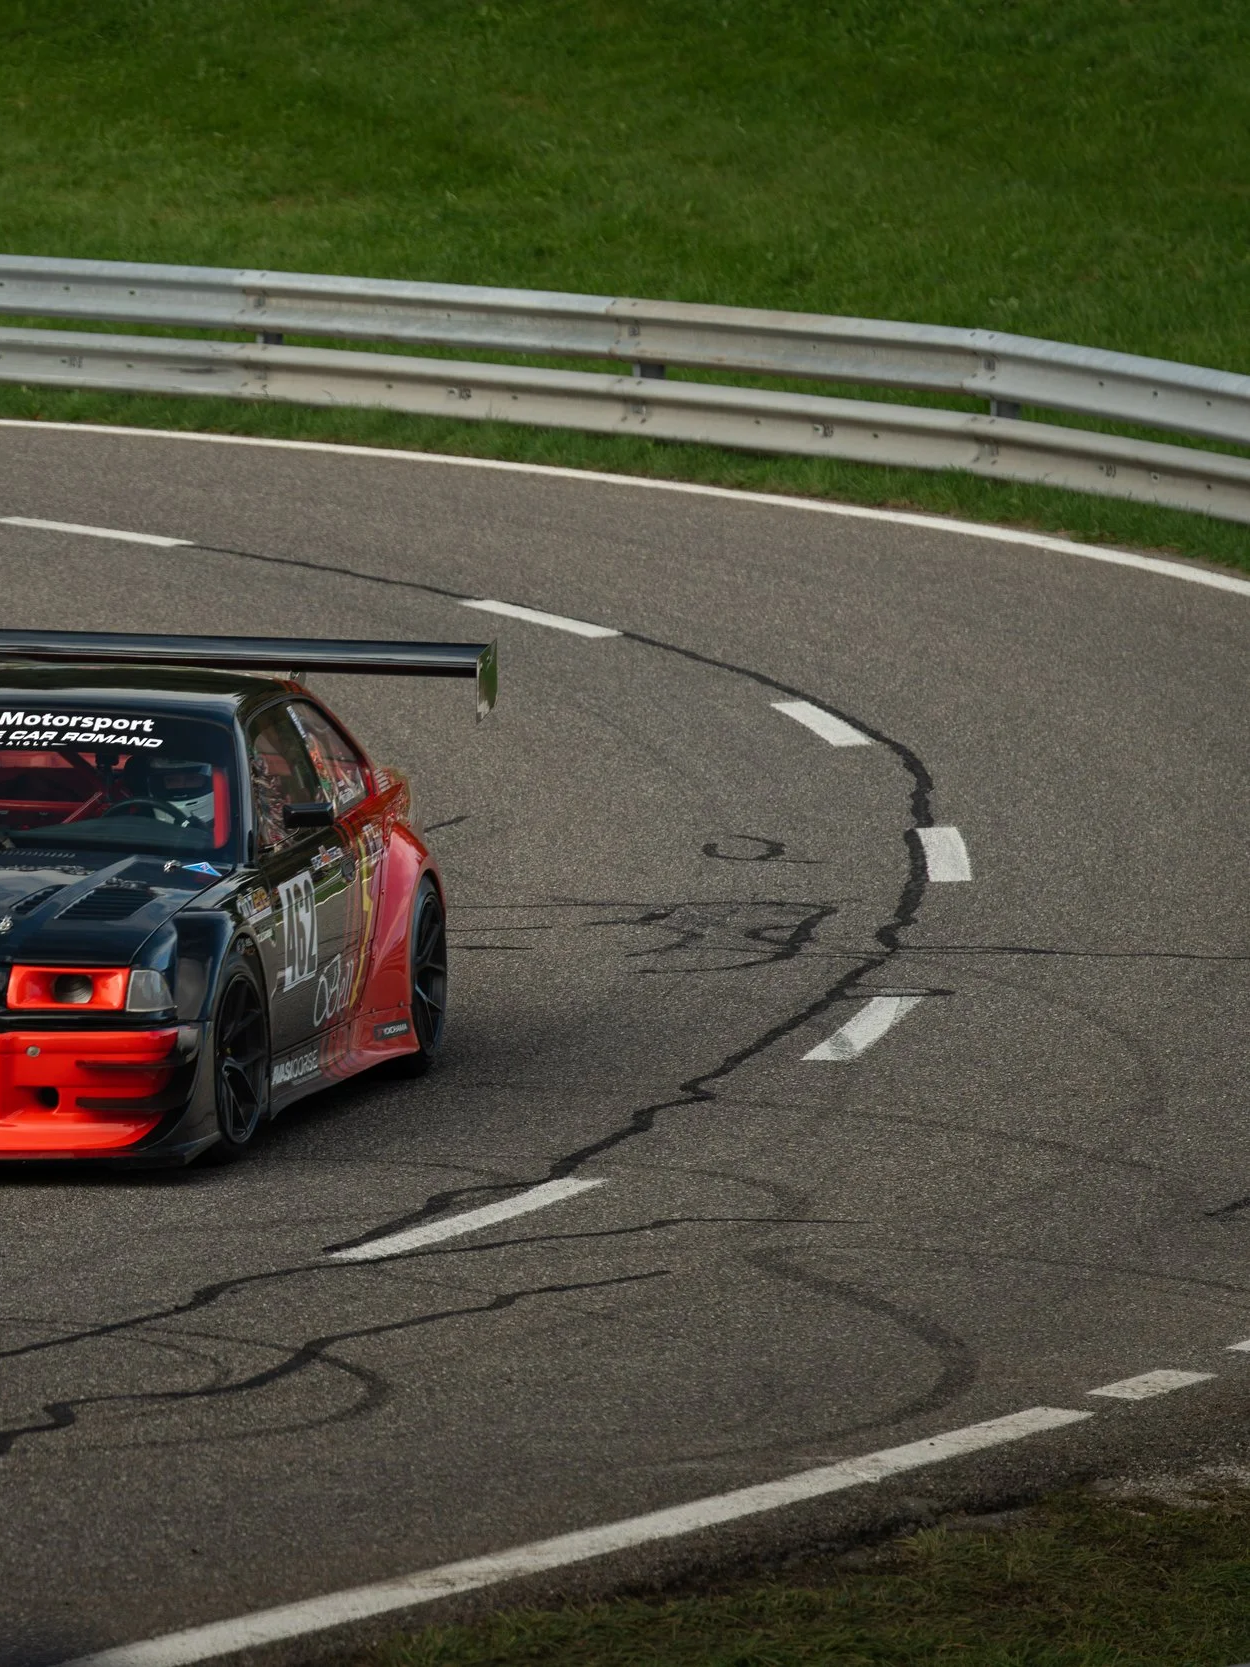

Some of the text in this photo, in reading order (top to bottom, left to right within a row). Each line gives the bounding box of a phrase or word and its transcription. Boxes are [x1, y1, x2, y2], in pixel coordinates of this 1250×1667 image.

[8, 730, 57, 741] CAR
[60, 732, 163, 748] ROMAND
[283, 880, 317, 982] 462
